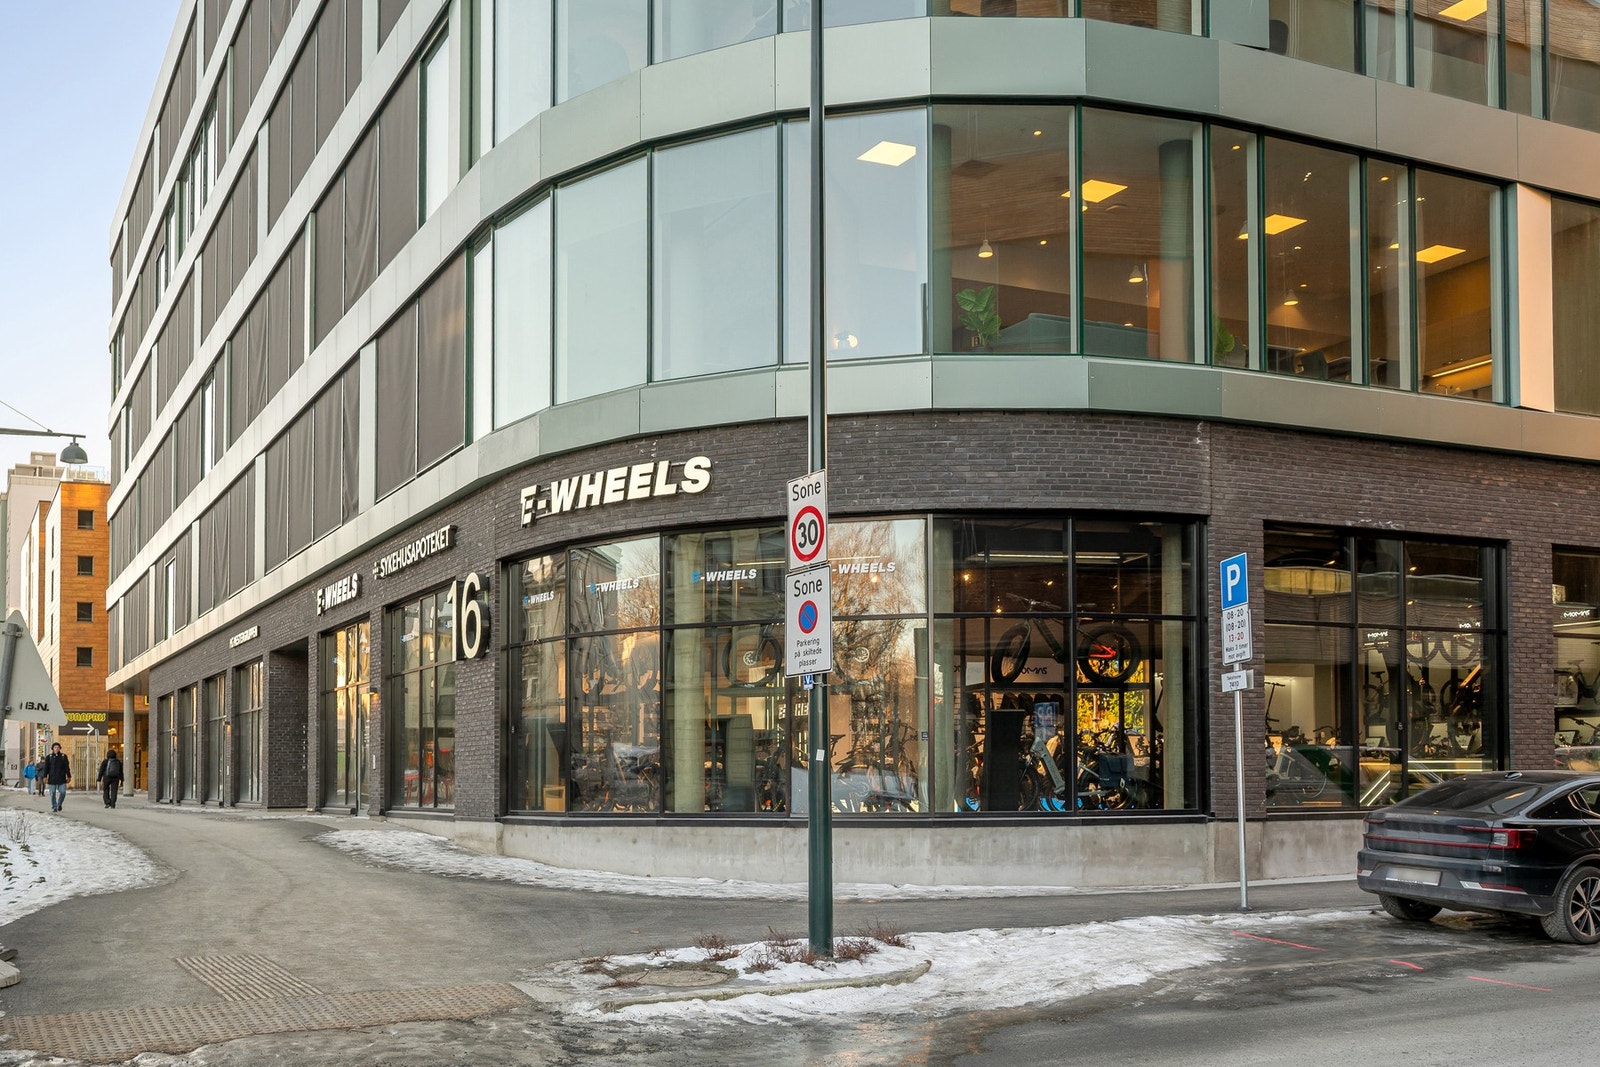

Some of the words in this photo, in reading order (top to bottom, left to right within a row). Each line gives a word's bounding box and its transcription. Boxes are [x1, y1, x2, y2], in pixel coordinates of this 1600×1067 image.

[521, 456, 712, 527] E-WHEELS
[792, 481, 821, 501] Sone
[798, 519, 819, 548] 30
[380, 525, 450, 577] SYKEHUSAPOTEKET
[690, 569, 757, 584] E-WHEELS
[832, 562, 896, 574] -WHEELS
[794, 579, 822, 597] Sone
[1227, 563, 1240, 601] P
[317, 573, 358, 616] E-WHEELS
[447, 572, 481, 661] 16
[1227, 608, 1244, 620] 08-20
[796, 637, 820, 648] Parkering
[794, 650, 801, 659] på
[802, 646, 822, 657] skiltede
[798, 657, 817, 668] plasser
